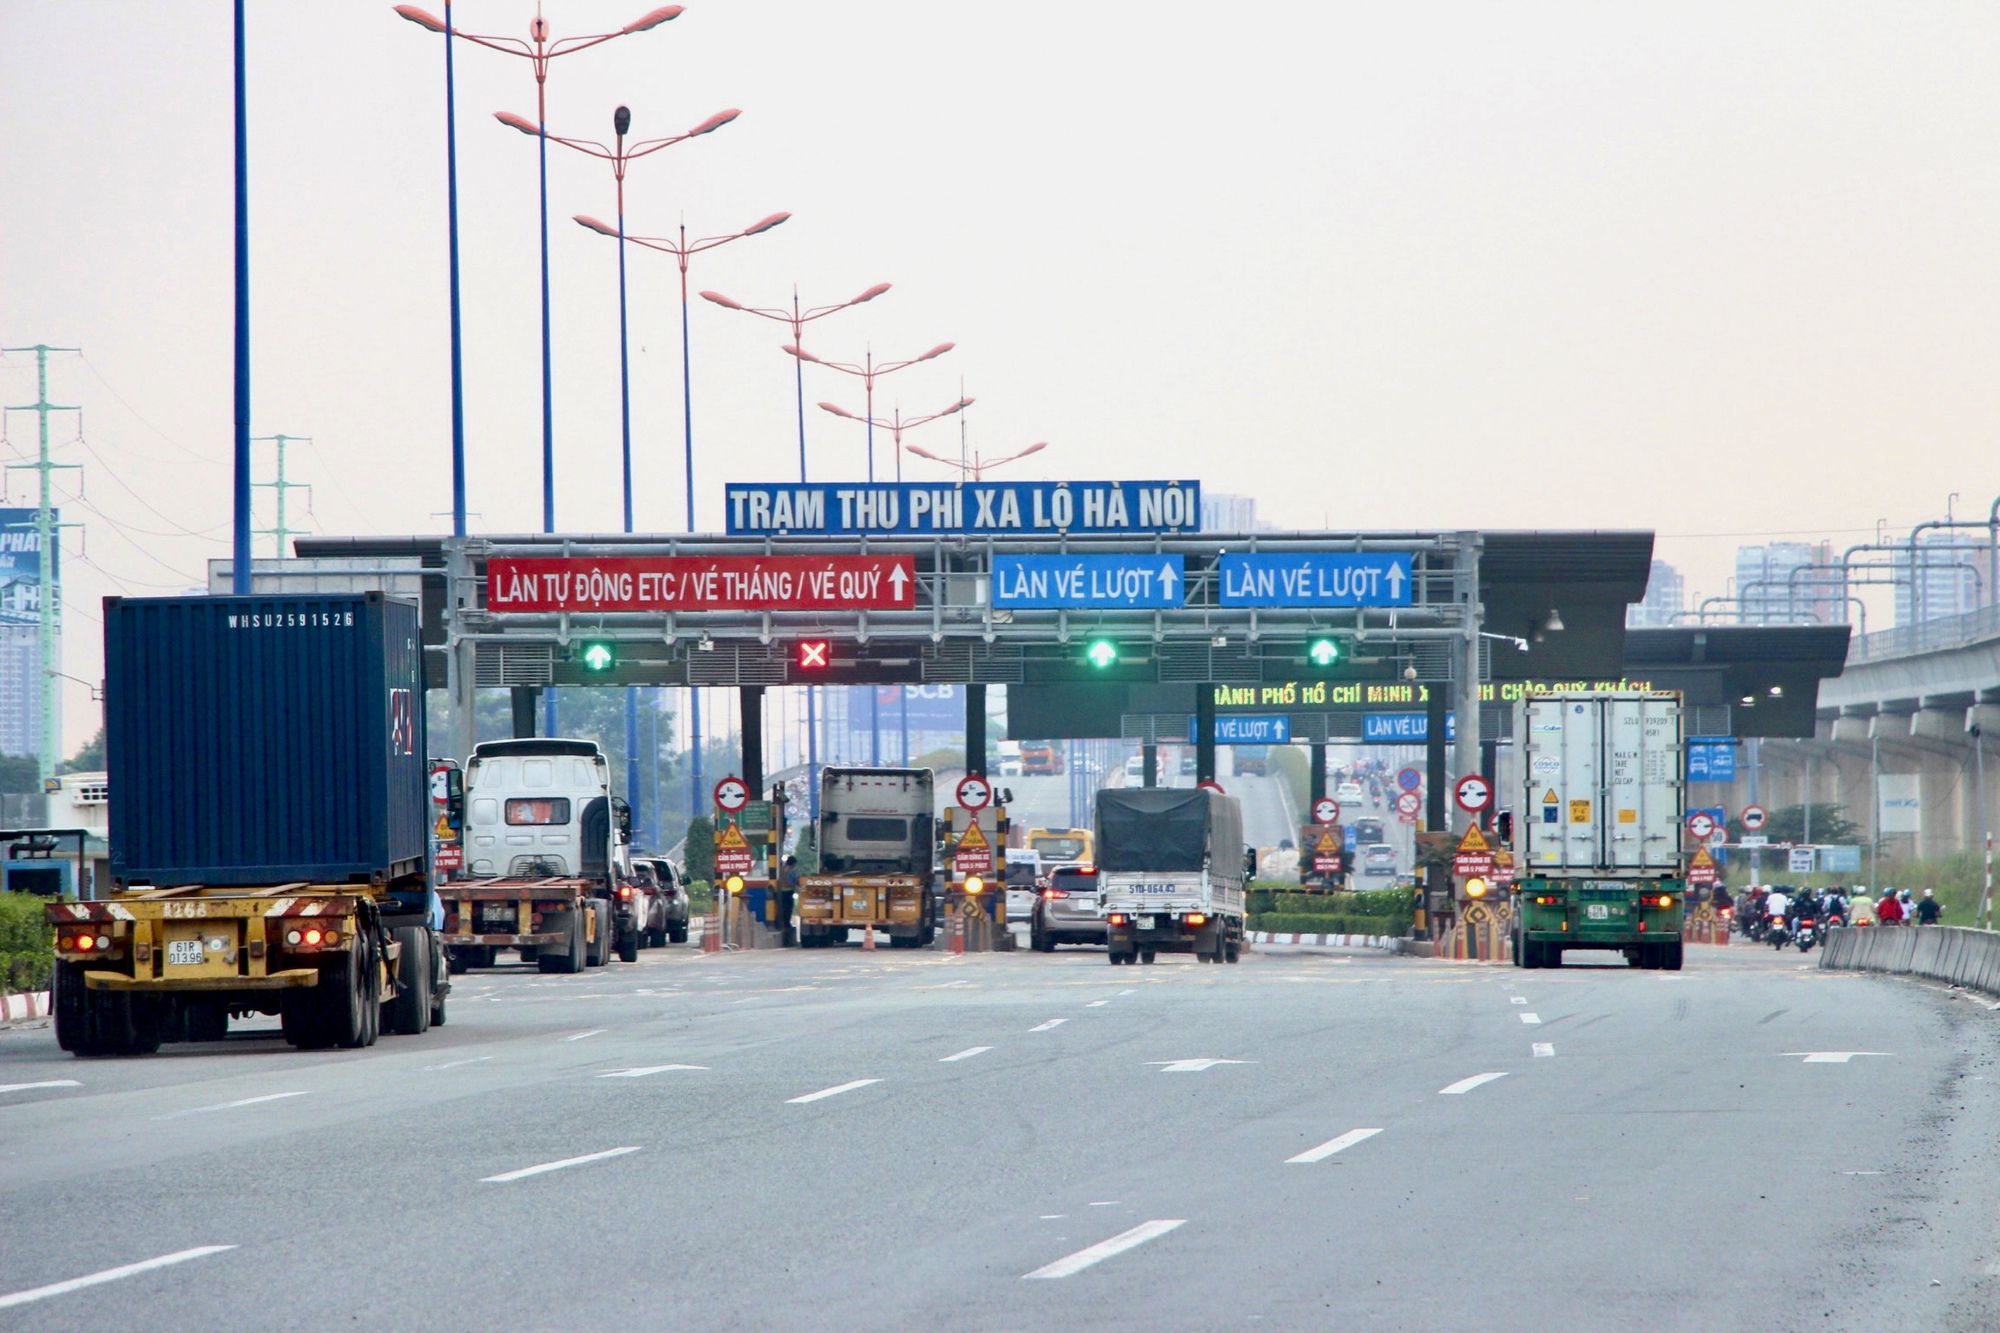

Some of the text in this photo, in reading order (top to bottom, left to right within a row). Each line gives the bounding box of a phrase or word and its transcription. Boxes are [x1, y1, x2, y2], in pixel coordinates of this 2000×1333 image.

[730, 480, 1195, 534] TRẠM THU PHÍ XA LỘ HÀ NỘI
[496, 566, 538, 602] LÀN
[543, 571, 571, 608] TỰ
[575, 567, 632, 607] ĐỘNG
[639, 573, 676, 601] ETC
[692, 564, 718, 600] VÉ
[722, 564, 792, 600] THÁNG
[809, 563, 836, 599] VÉ
[840, 564, 881, 599] QUÝ
[1000, 563, 1154, 603] LÀN VÉ LƯỢT
[1226, 562, 1381, 602] LÀN VÉ LƯỢT
[1214, 684, 1255, 706] HÀNH
[1262, 681, 1298, 704] PHỐ
[1333, 683, 1362, 703] CHÍ
[1367, 685, 1412, 703] MINH
[1221, 718, 1237, 737] VÉ
[1239, 721, 1269, 740] LƯỢT
[1367, 715, 1393, 736] LÀN
[1394, 715, 1410, 735] VÉ
[176, 942, 195, 953] 61R
